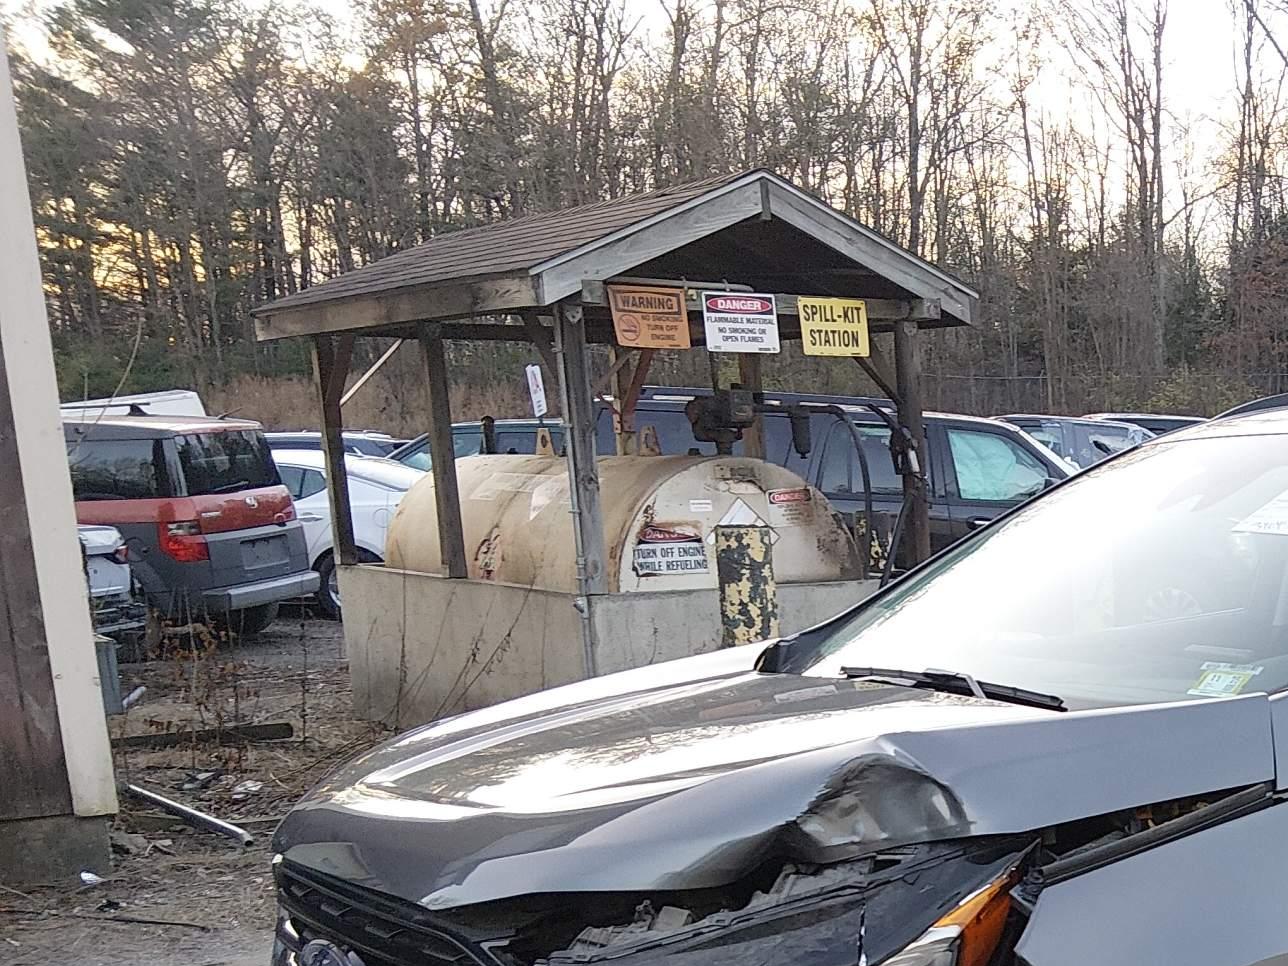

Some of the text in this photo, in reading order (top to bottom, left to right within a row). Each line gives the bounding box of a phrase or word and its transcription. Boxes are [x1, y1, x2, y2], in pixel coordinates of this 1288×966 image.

[622, 295, 674, 310] WARNING
[717, 299, 762, 311] DANGER
[802, 303, 862, 324] SPILL-KIT
[706, 316, 775, 326] FLAMMABLE MATERIAL
[718, 326, 727, 334] NO
[728, 327, 757, 335] SMOKING
[651, 333, 676, 341] ENGINE
[722, 335, 739, 343] OPEN
[809, 328, 859, 348] STATION
[636, 545, 706, 559] TURN OFF ENGINE
[639, 559, 709, 572] WHILE REFUELING
